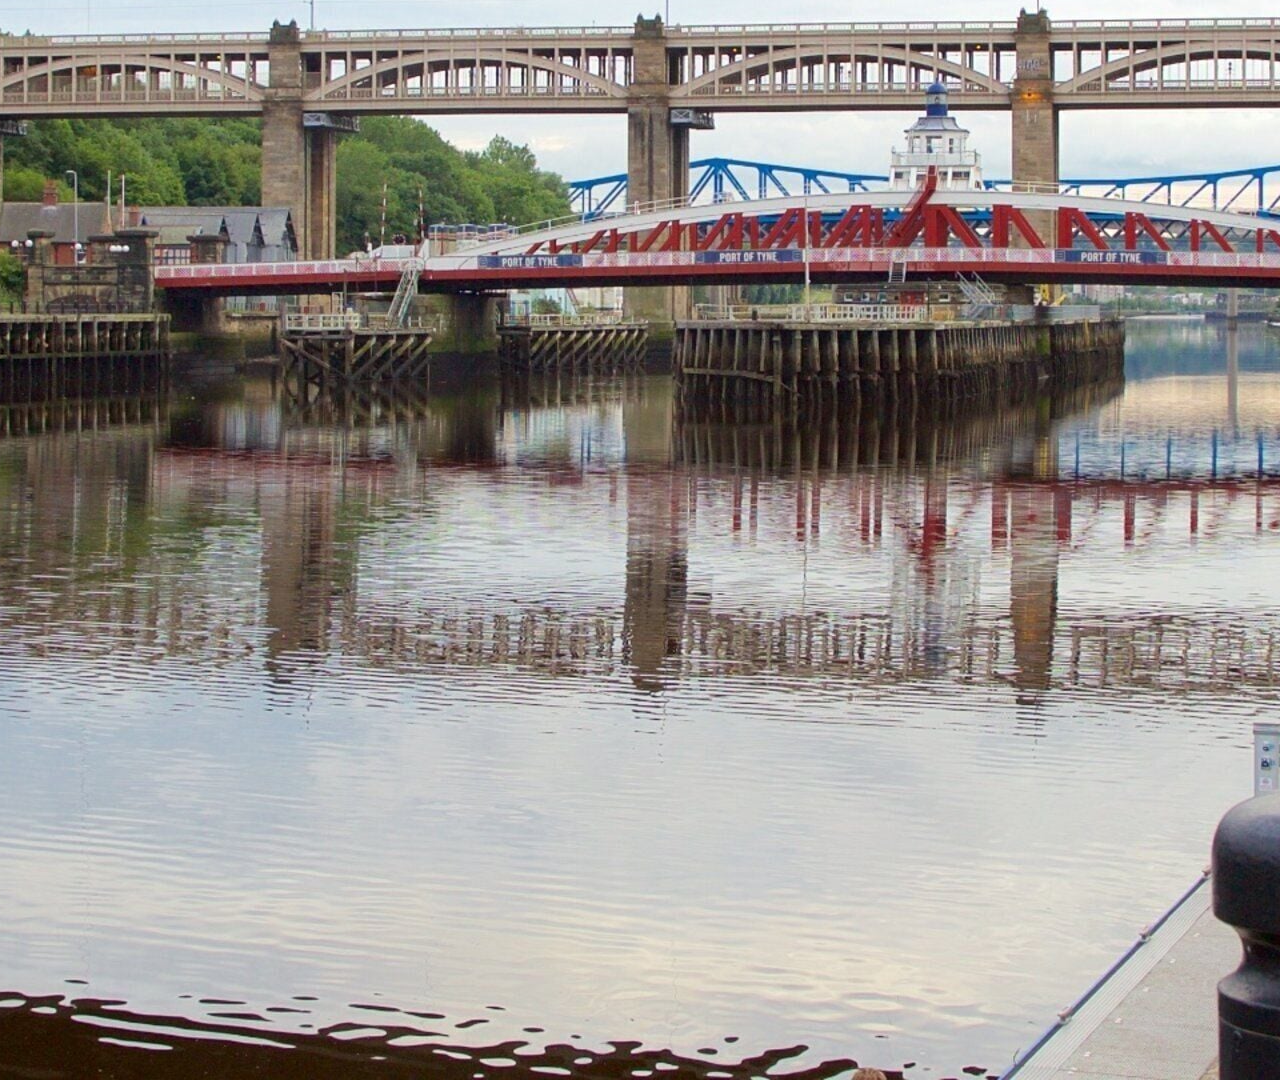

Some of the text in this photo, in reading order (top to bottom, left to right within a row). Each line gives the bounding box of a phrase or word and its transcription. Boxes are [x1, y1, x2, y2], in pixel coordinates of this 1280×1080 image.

[501, 256, 559, 267] PORT OF TYNE
[719, 251, 778, 262] PORT OF TYNE
[1080, 252, 1141, 263] PORT OF TYNE
